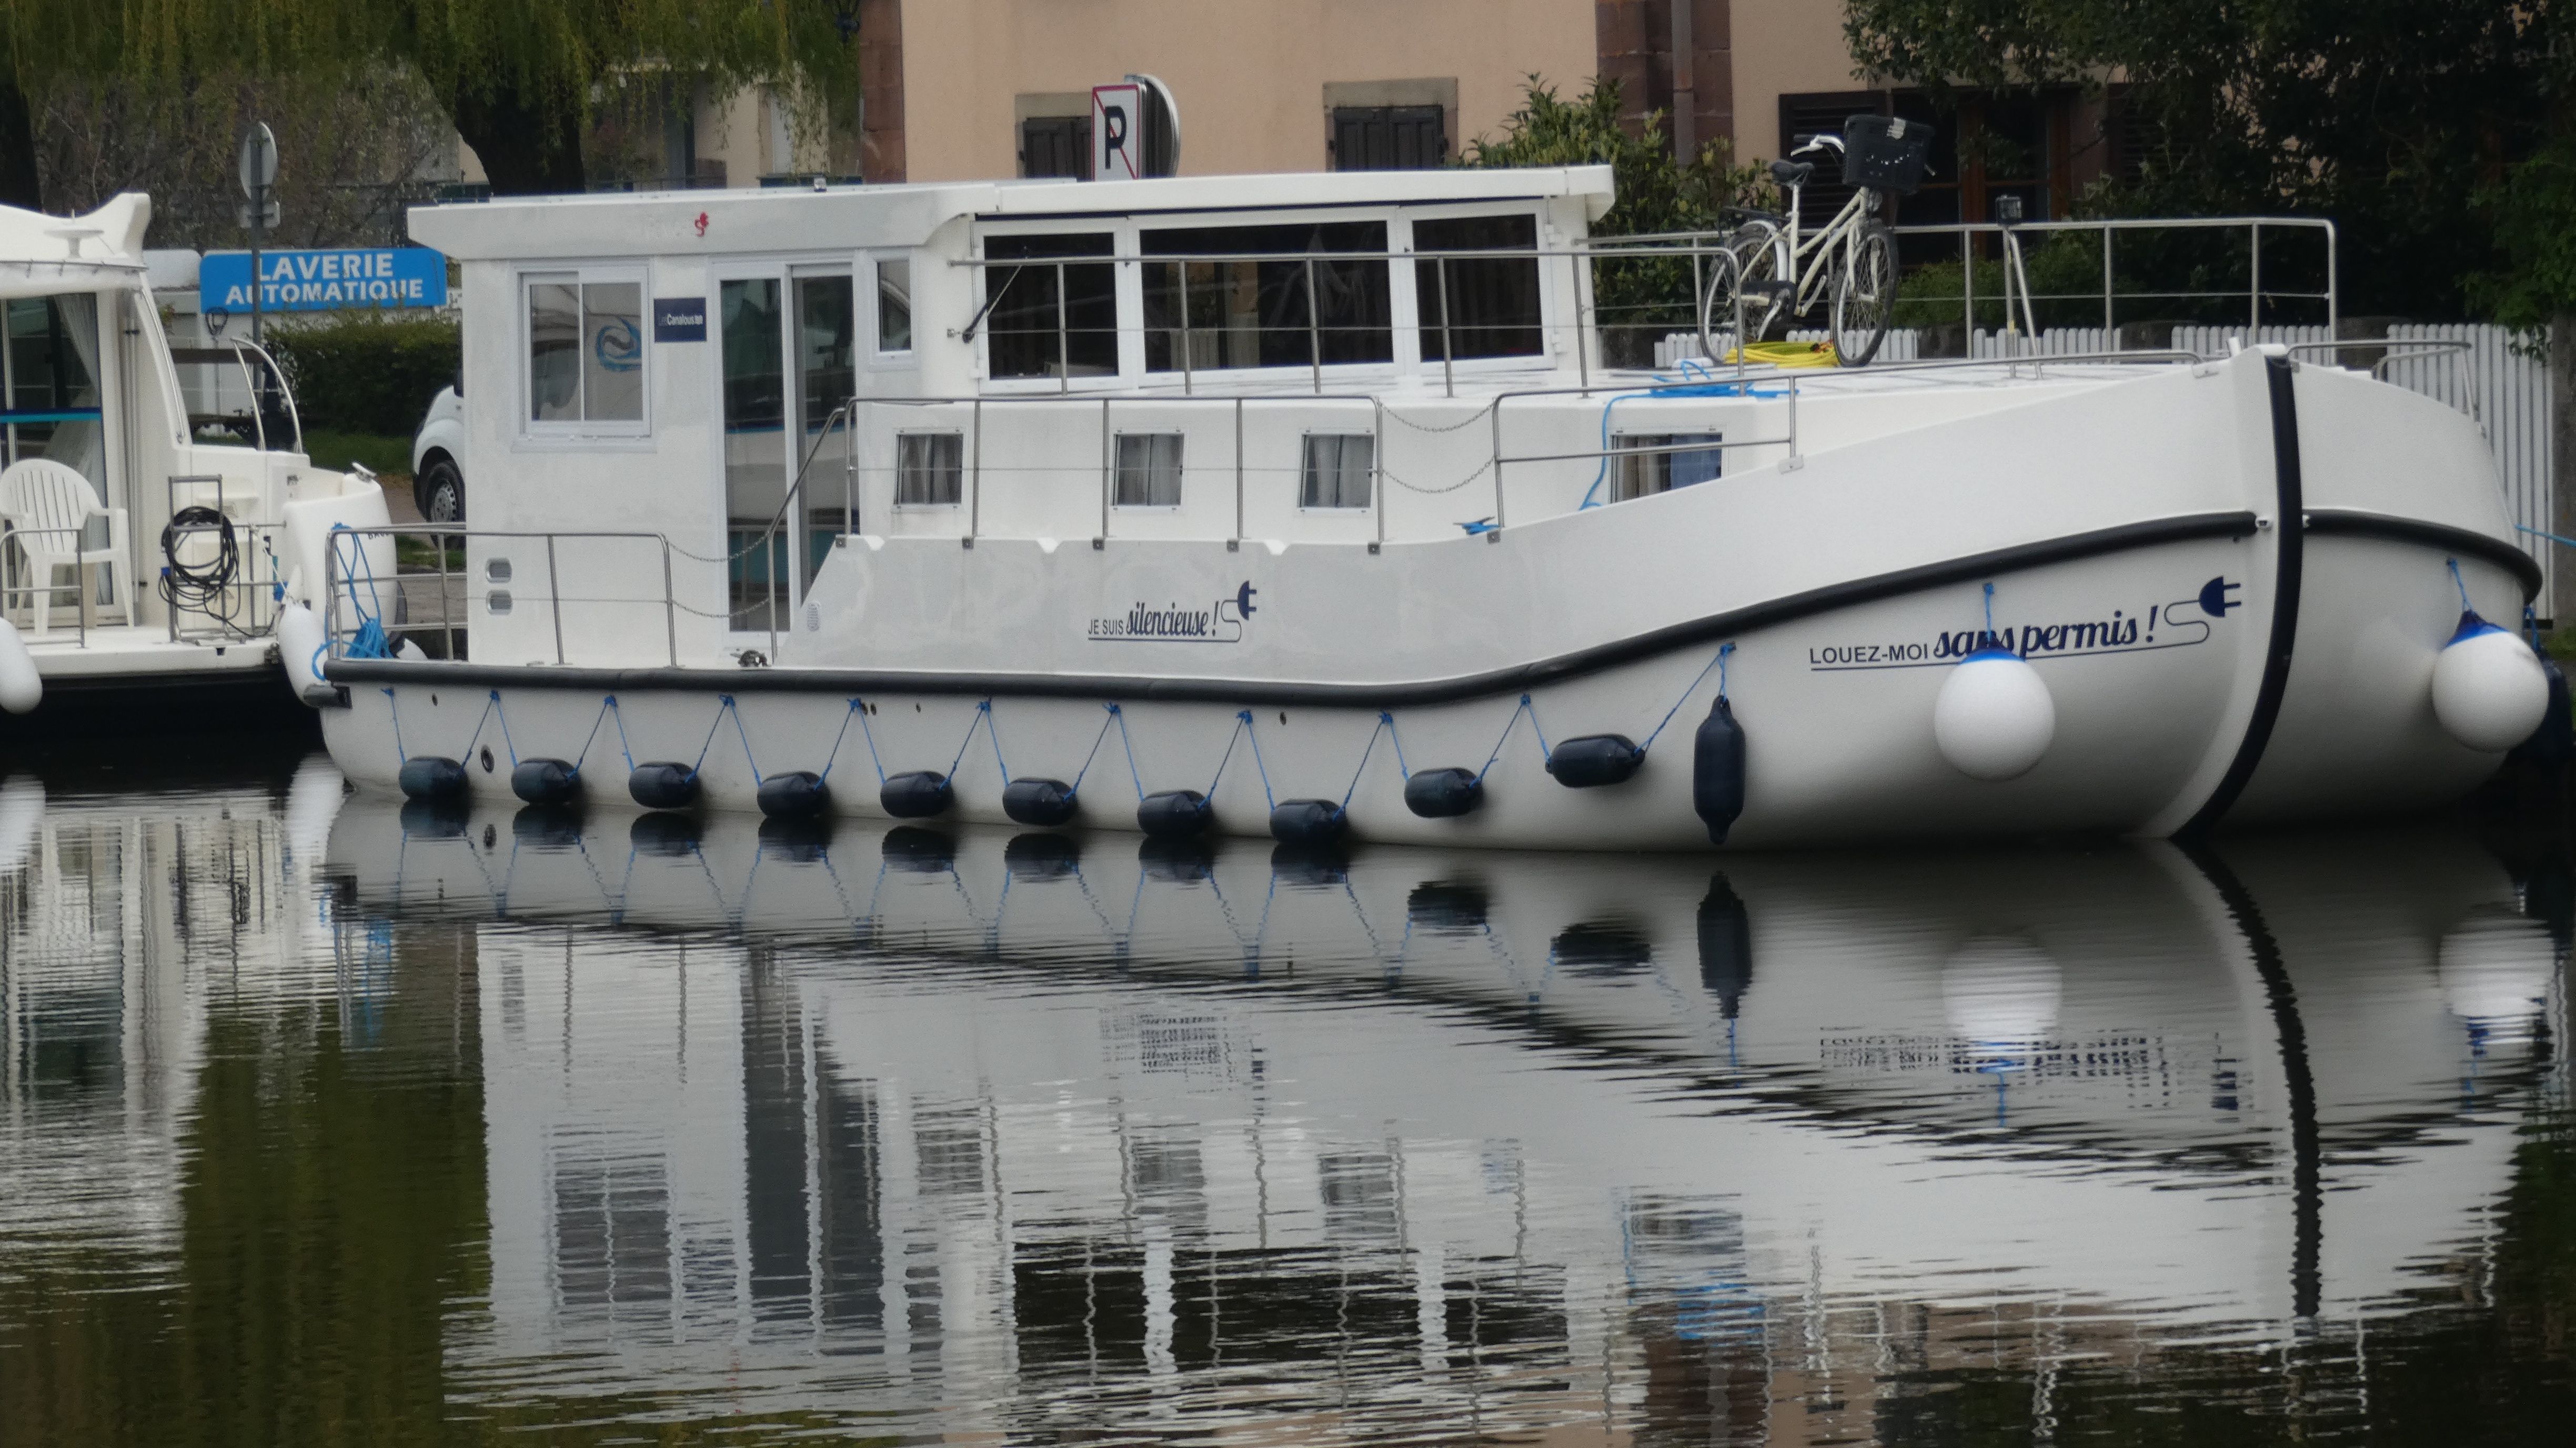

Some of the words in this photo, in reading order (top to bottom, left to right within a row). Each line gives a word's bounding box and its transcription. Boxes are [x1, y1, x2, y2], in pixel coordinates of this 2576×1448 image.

[1105, 105, 1127, 169] P
[259, 253, 394, 281] LAVERIE
[225, 278, 424, 305] AUTOMATIQUE
[1088, 619, 1099, 635] JE
[1102, 619, 1124, 635] SUIS
[1809, 642, 1928, 664] LOUEZ-MOI
